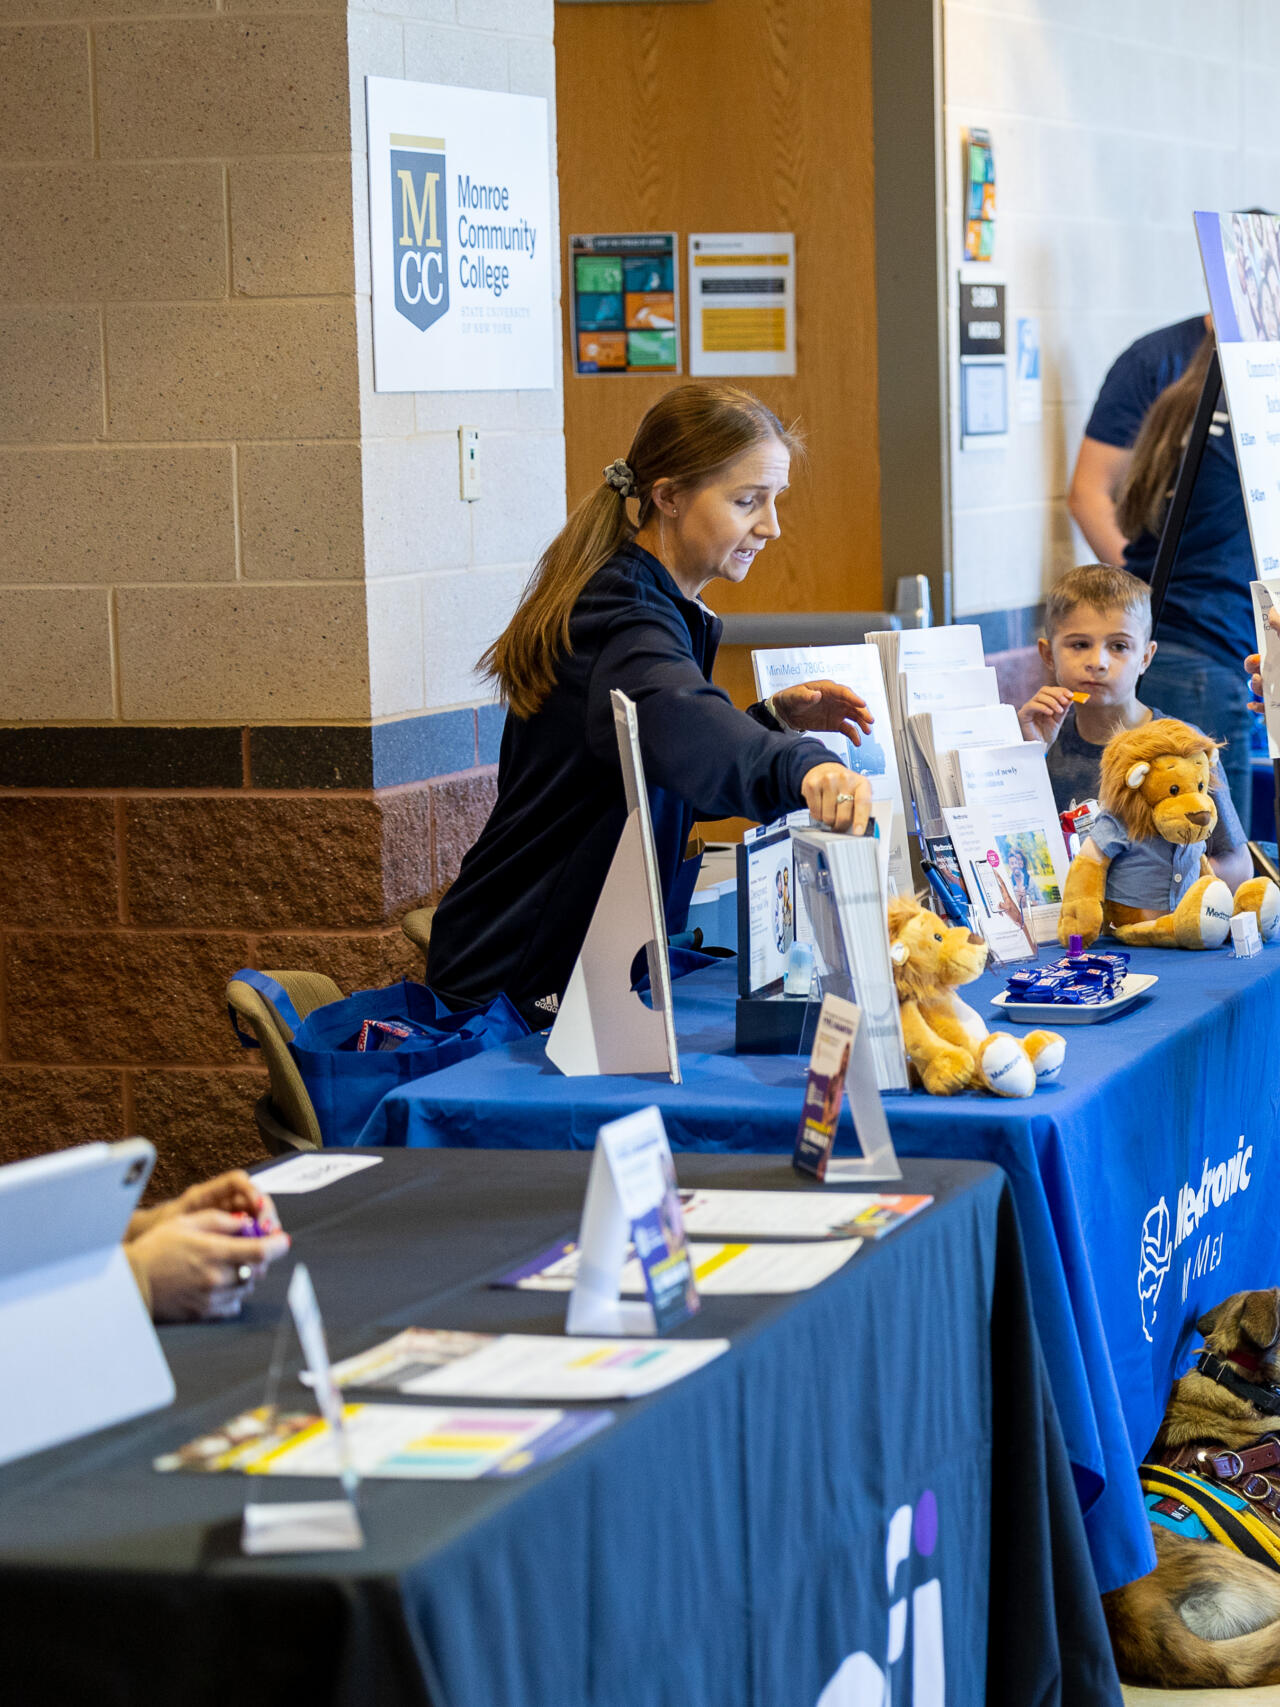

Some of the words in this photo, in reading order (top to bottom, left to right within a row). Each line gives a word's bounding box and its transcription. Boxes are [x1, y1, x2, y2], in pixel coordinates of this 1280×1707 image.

[457, 174, 510, 211] Monroe
[458, 214, 537, 259] Community
[459, 255, 510, 297] College
